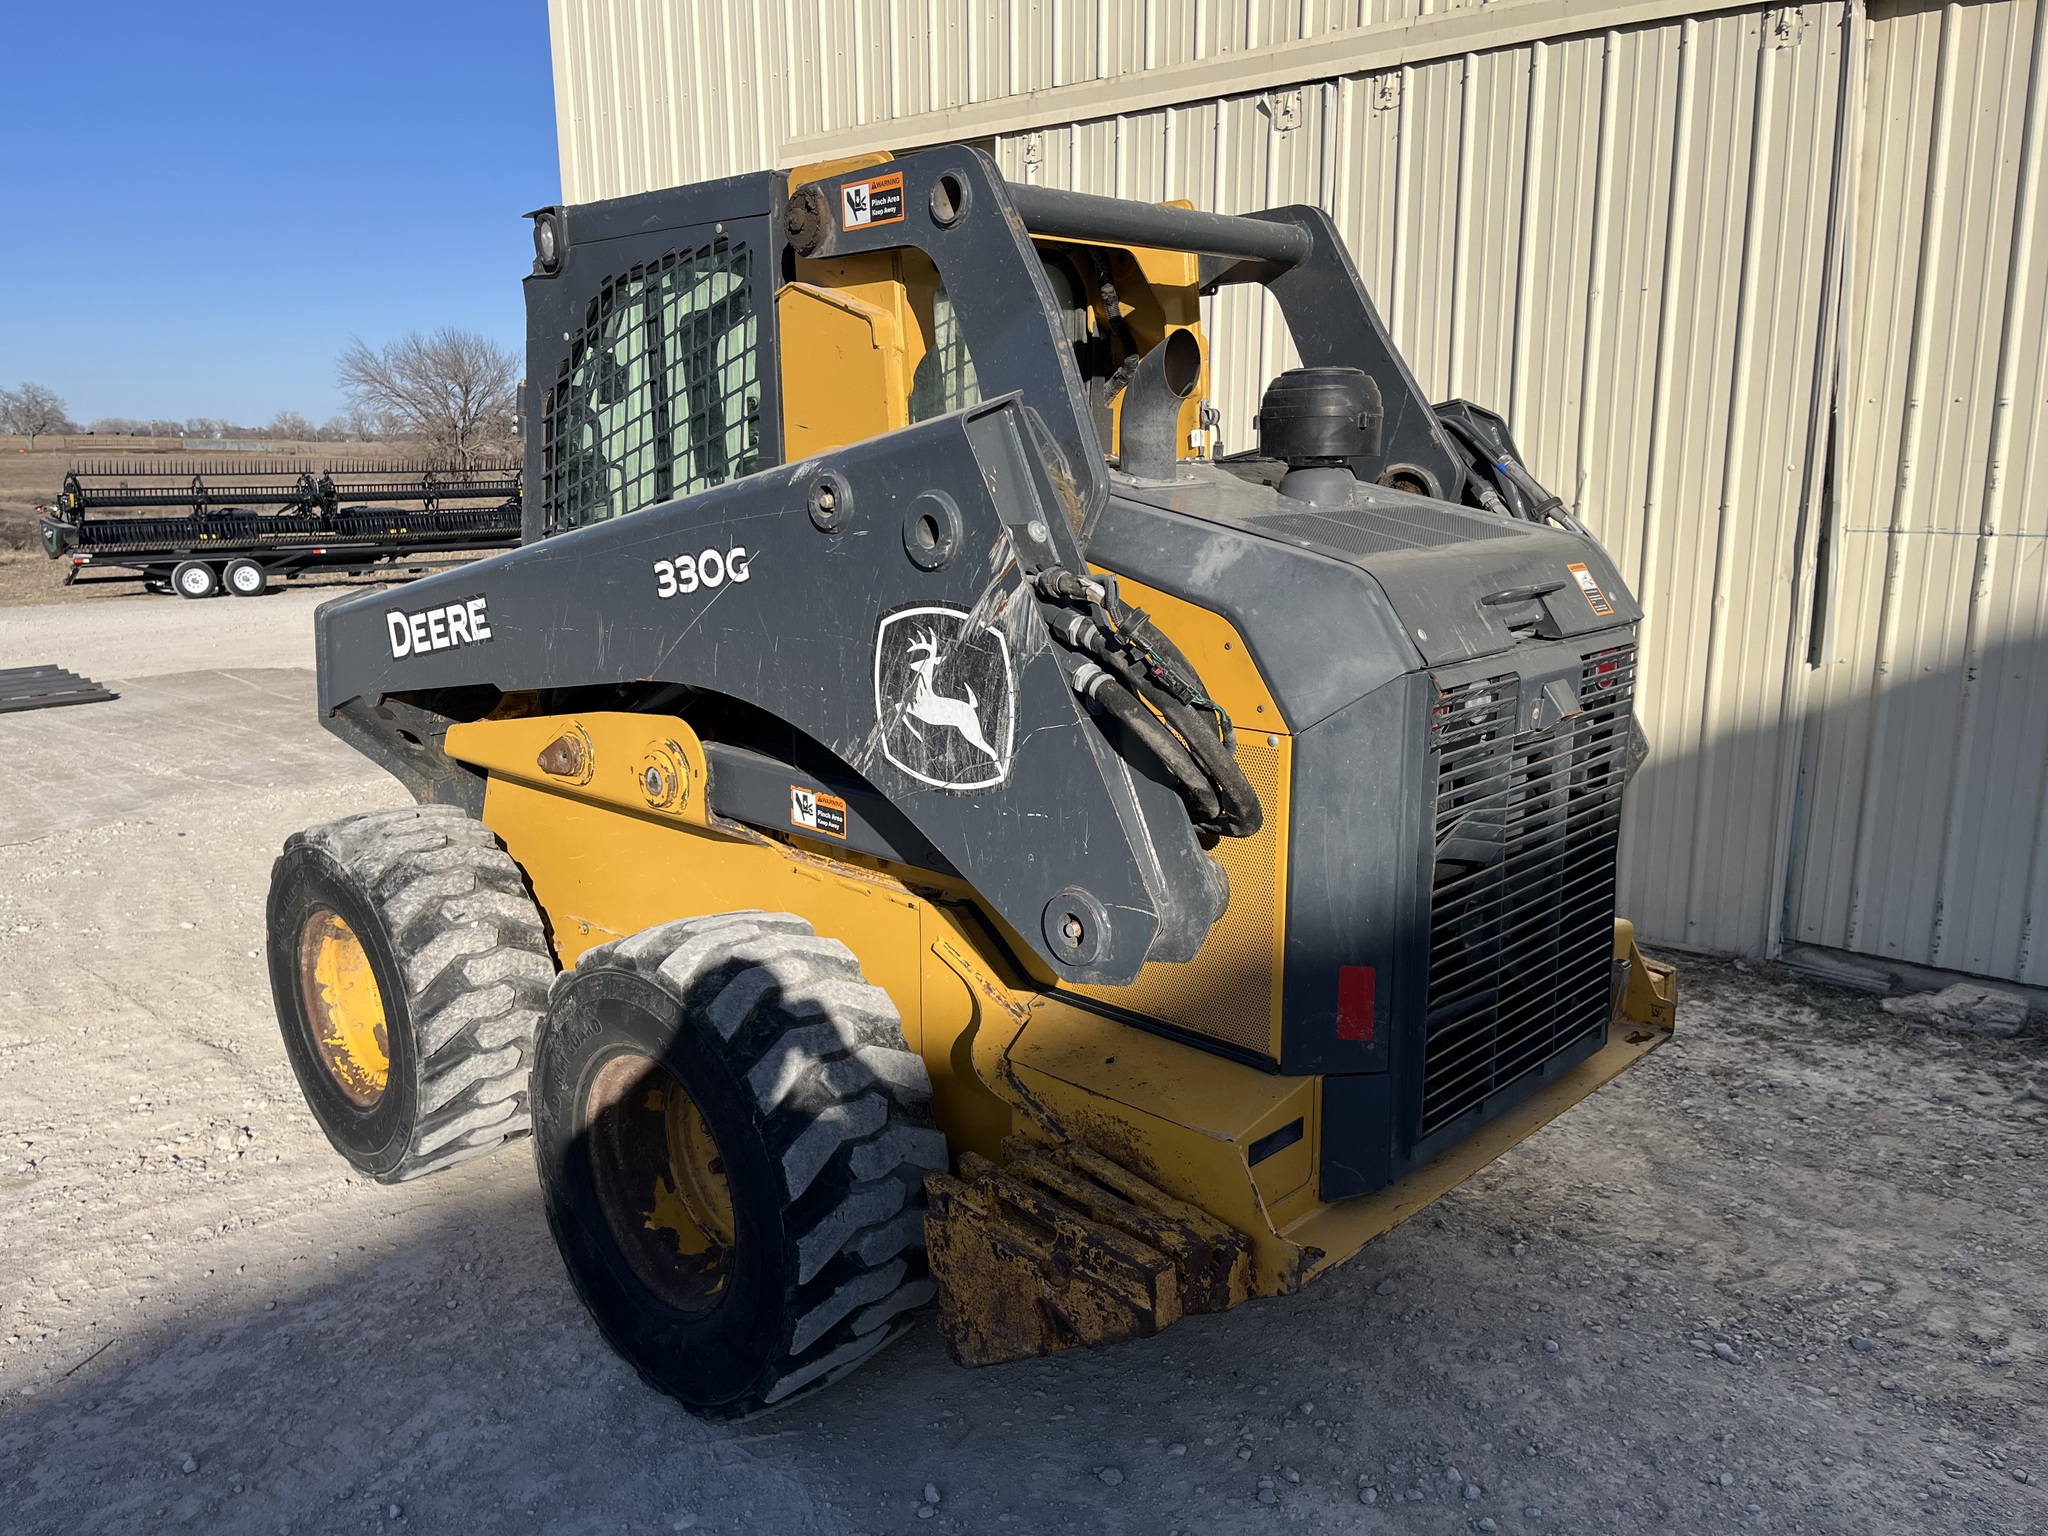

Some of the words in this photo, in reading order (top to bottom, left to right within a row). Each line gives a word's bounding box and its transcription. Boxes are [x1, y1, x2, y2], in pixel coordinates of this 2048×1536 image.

[876, 177, 900, 189] WARNING
[871, 197, 886, 206] Pinch
[887, 195, 900, 204] Area
[872, 208, 883, 216] Keep
[884, 206, 896, 214] Away
[653, 547, 750, 598] 330G
[386, 598, 491, 658] DEERE
[817, 809, 831, 819] Pinch
[831, 813, 843, 822] Area
[817, 818, 828, 827] Keep
